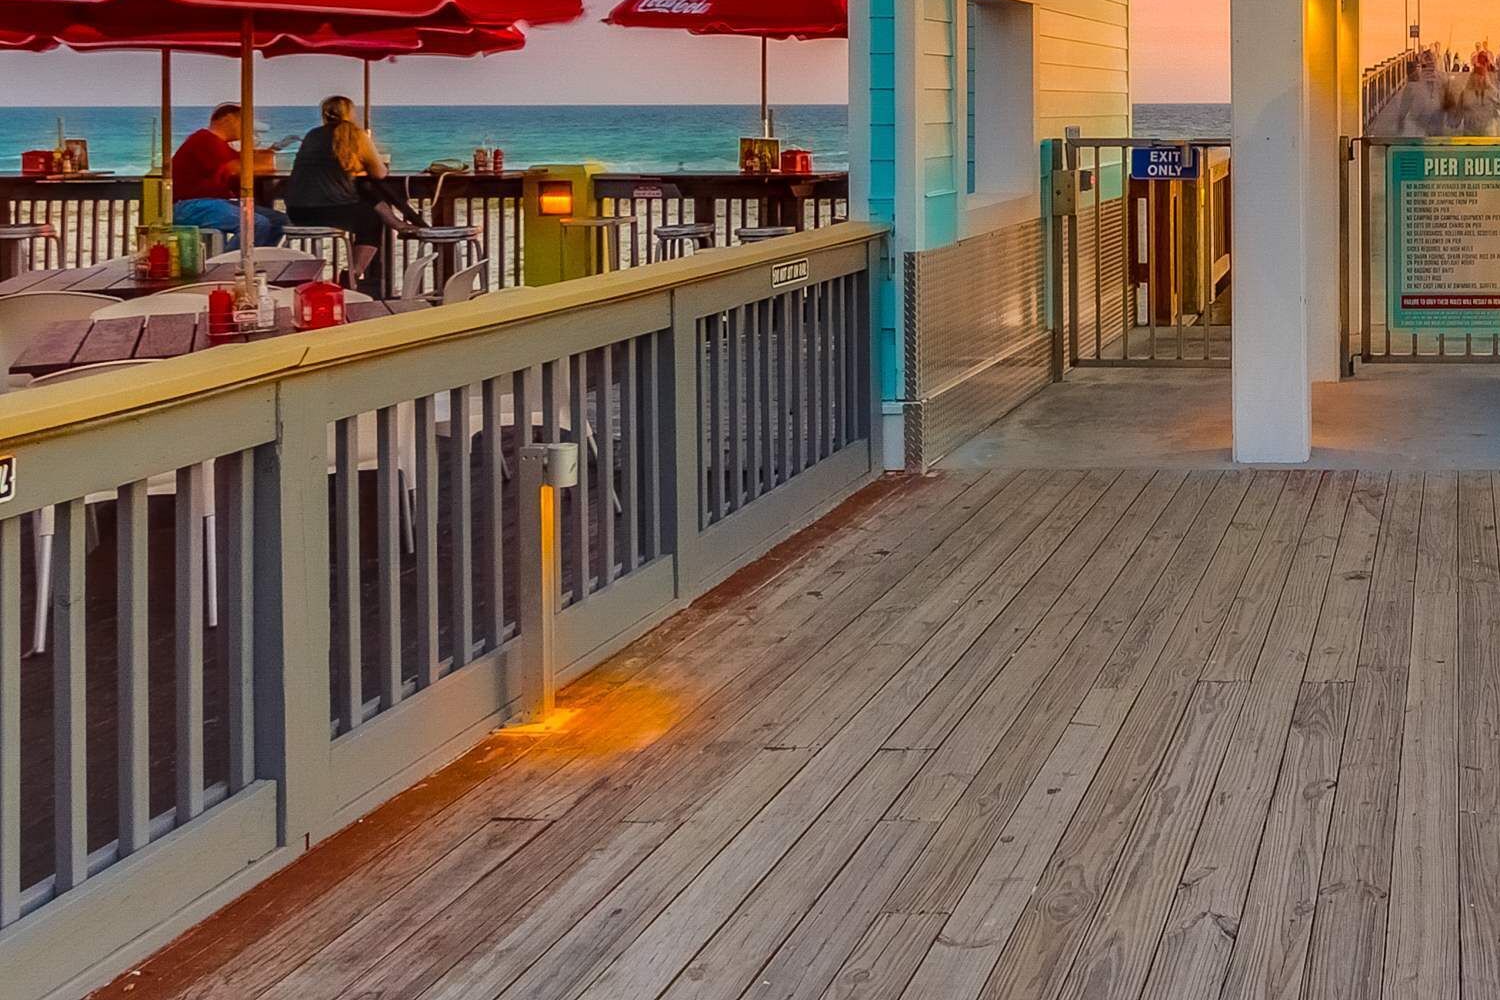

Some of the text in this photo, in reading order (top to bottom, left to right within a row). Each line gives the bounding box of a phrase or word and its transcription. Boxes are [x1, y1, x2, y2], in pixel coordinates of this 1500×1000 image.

[1150, 150, 1180, 162] EXIT
[1147, 164, 1182, 176] ONLY
[1424, 157, 1458, 176] PIER
